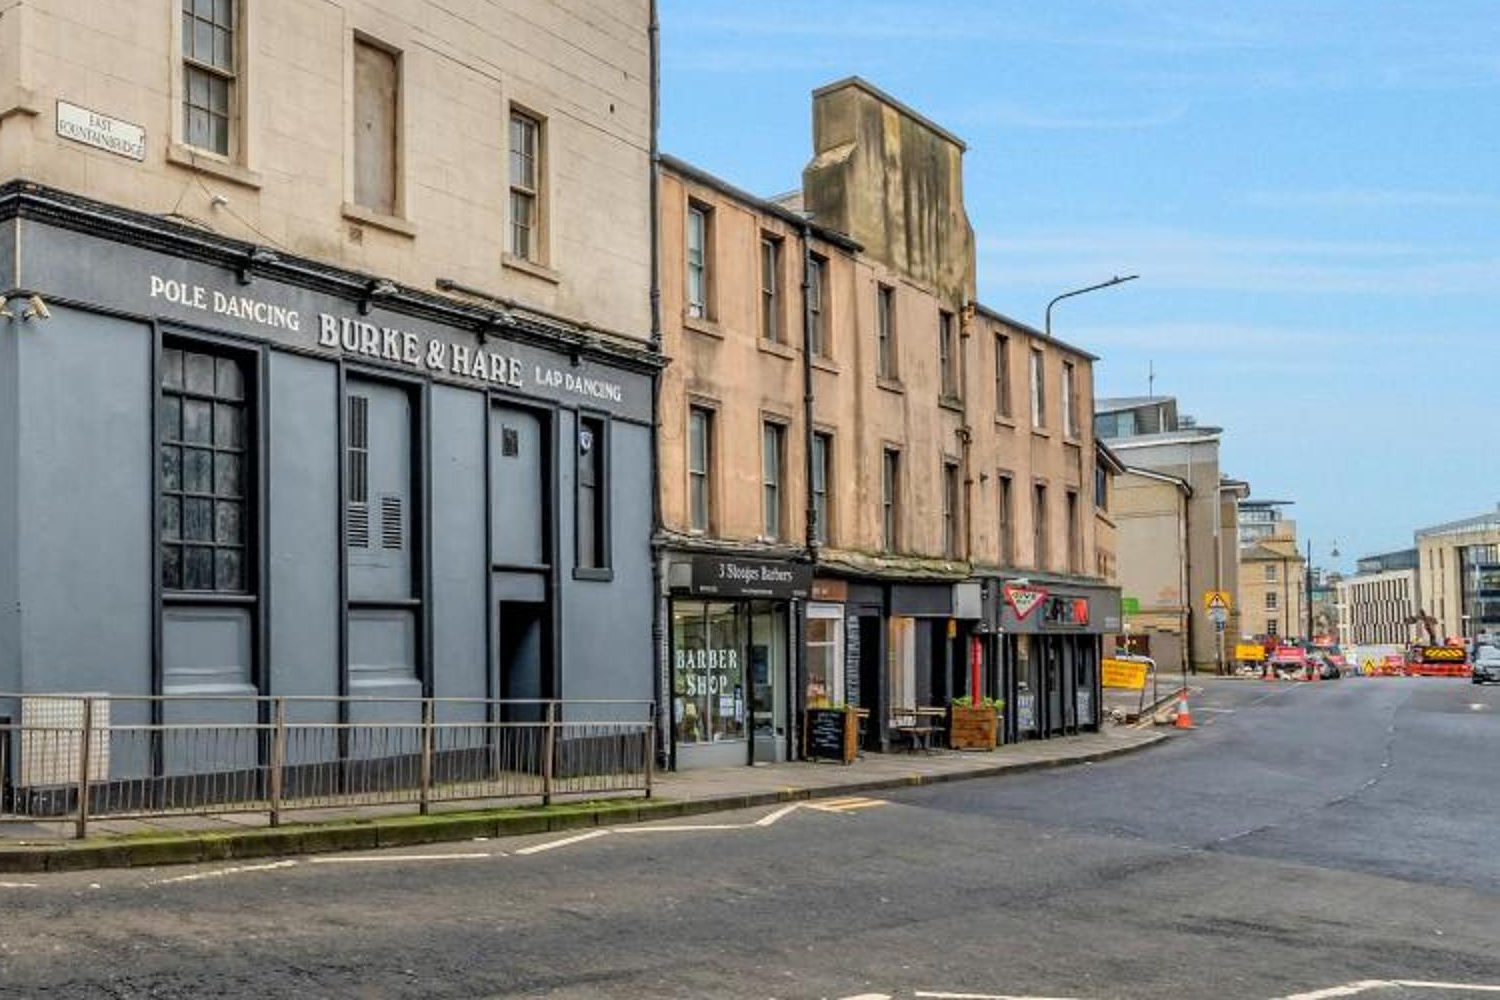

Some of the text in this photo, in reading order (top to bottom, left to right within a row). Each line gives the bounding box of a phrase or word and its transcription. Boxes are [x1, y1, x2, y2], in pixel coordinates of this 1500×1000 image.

[88, 114, 111, 132] EAST
[150, 275, 300, 331] POLE DANCING
[319, 312, 523, 388] BURKE & HARE
[536, 366, 623, 402] LAP DANCING
[676, 648, 737, 669] BARBER
[685, 673, 728, 697] SHOP
